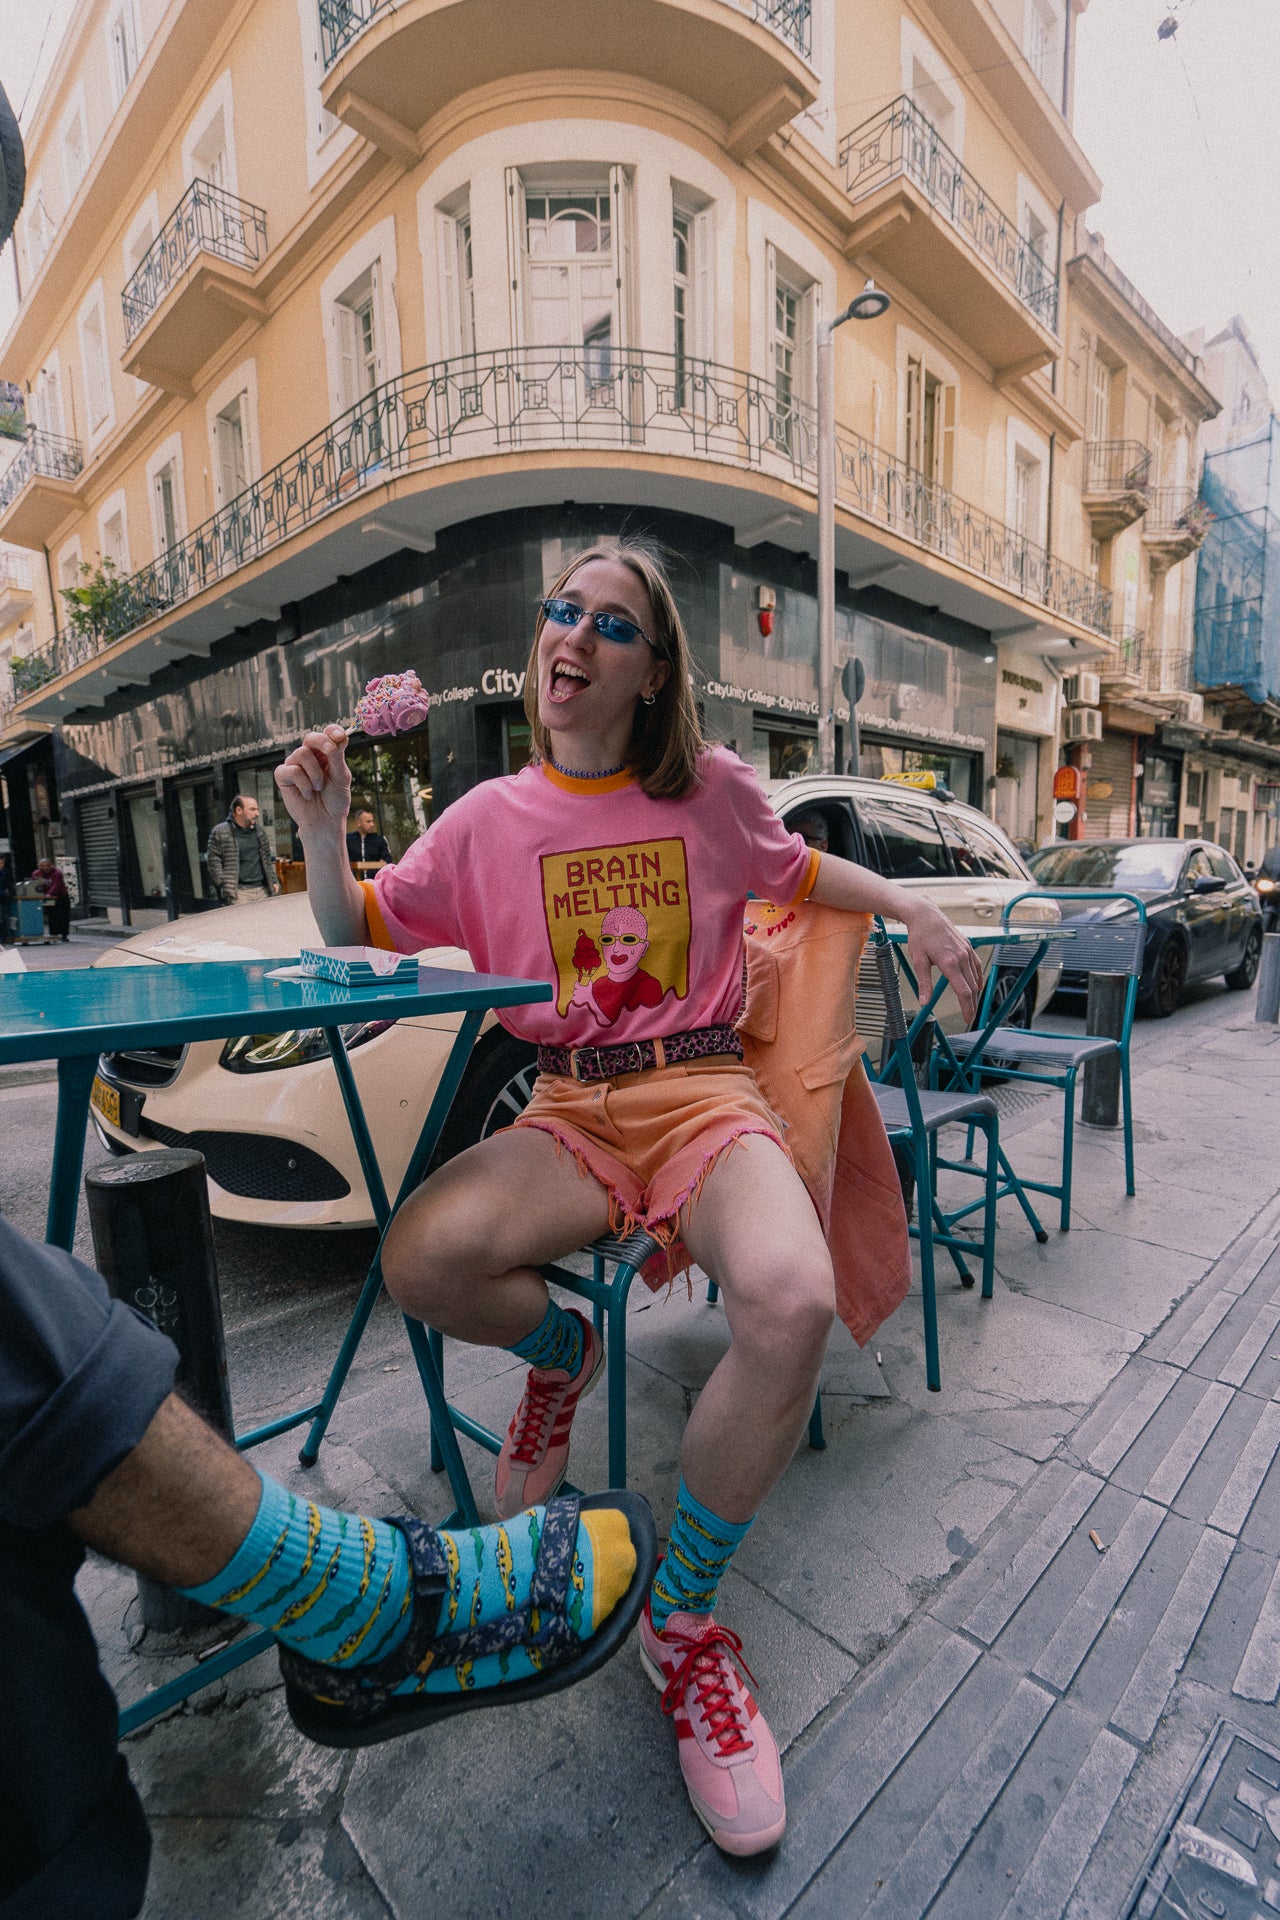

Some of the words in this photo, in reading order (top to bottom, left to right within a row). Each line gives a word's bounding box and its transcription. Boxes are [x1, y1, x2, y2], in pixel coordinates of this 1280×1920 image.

[443, 686, 475, 703] College
[707, 681, 747, 703] CityUnity
[747, 688, 776, 708] College
[566, 851, 662, 888] BRAIN
[553, 879, 681, 919] MELTING
